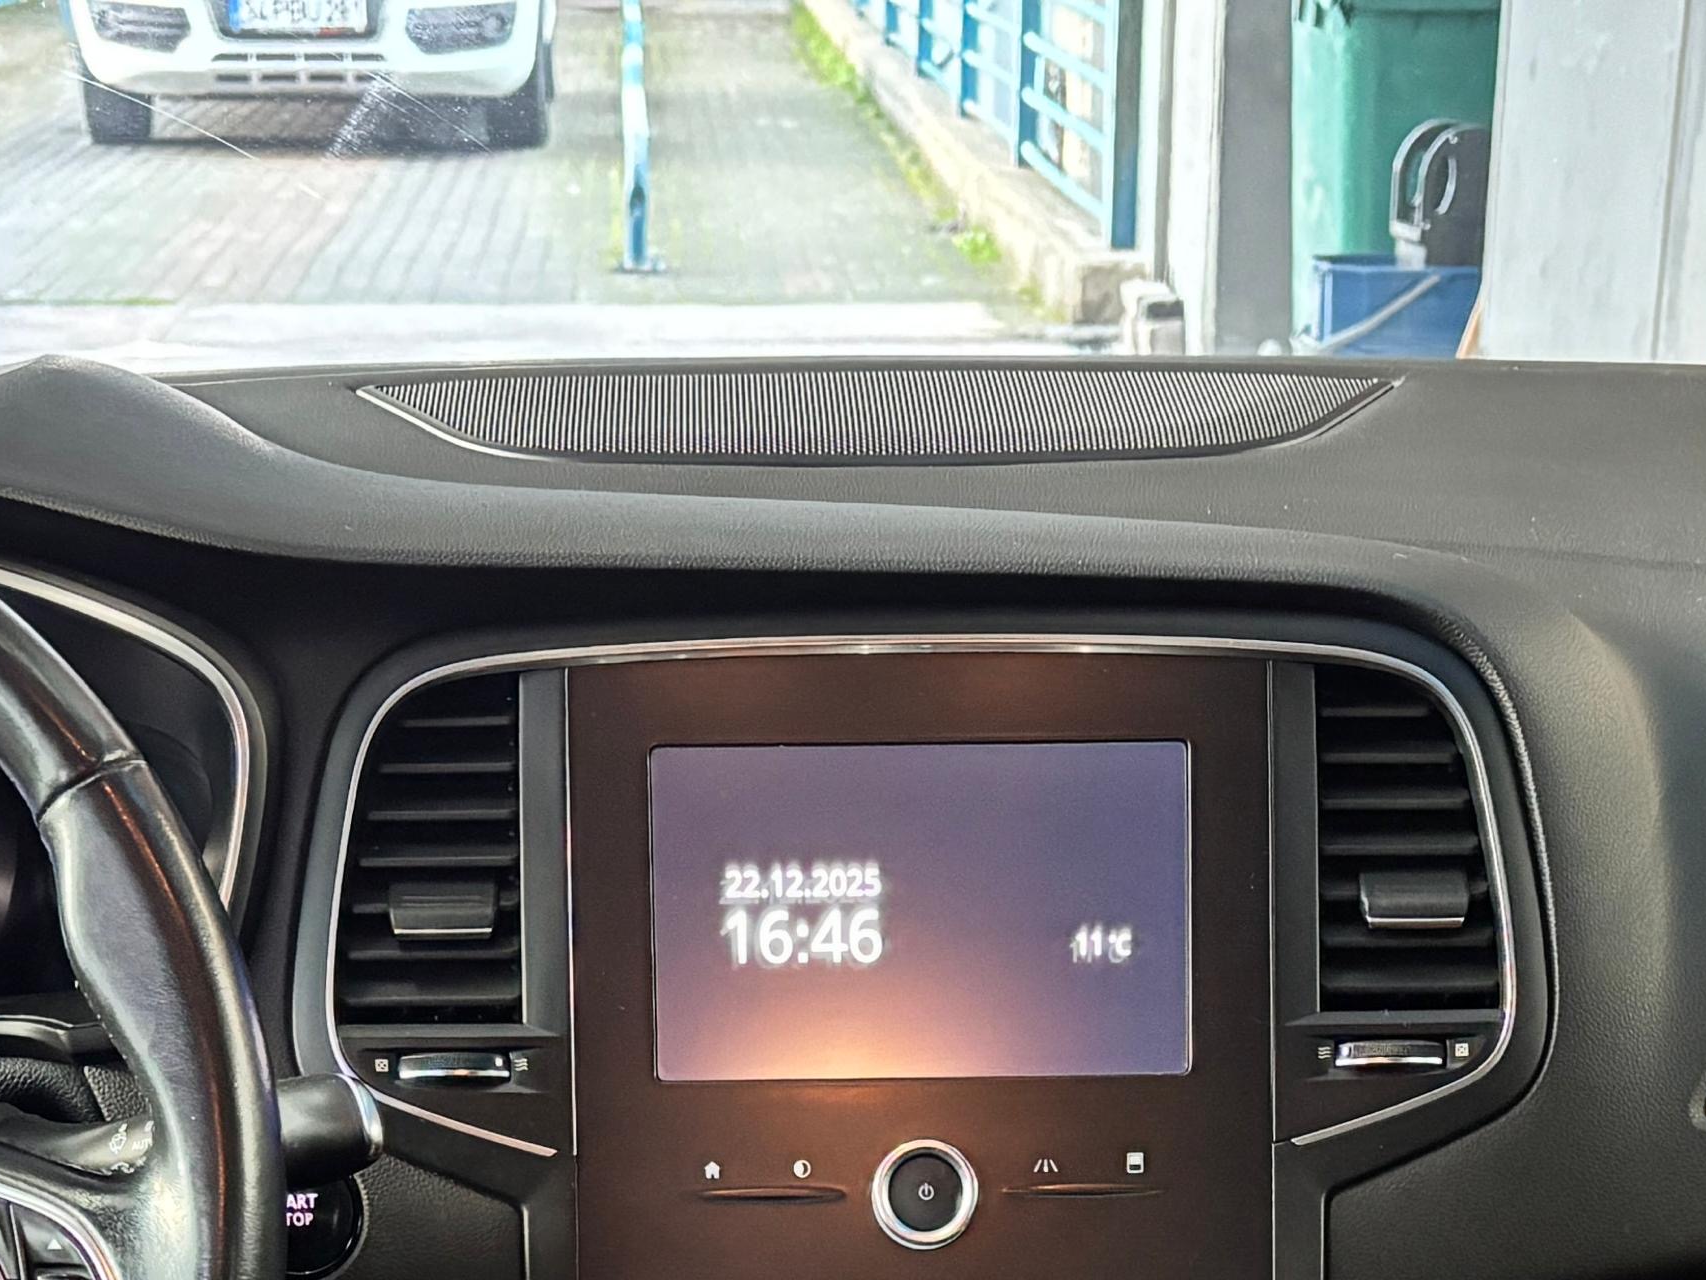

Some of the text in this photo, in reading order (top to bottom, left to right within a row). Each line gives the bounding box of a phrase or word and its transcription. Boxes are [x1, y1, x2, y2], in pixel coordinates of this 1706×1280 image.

[724, 868, 882, 899] 22.12.2025
[725, 908, 883, 964] 16:46
[286, 1193, 319, 1210] ART
